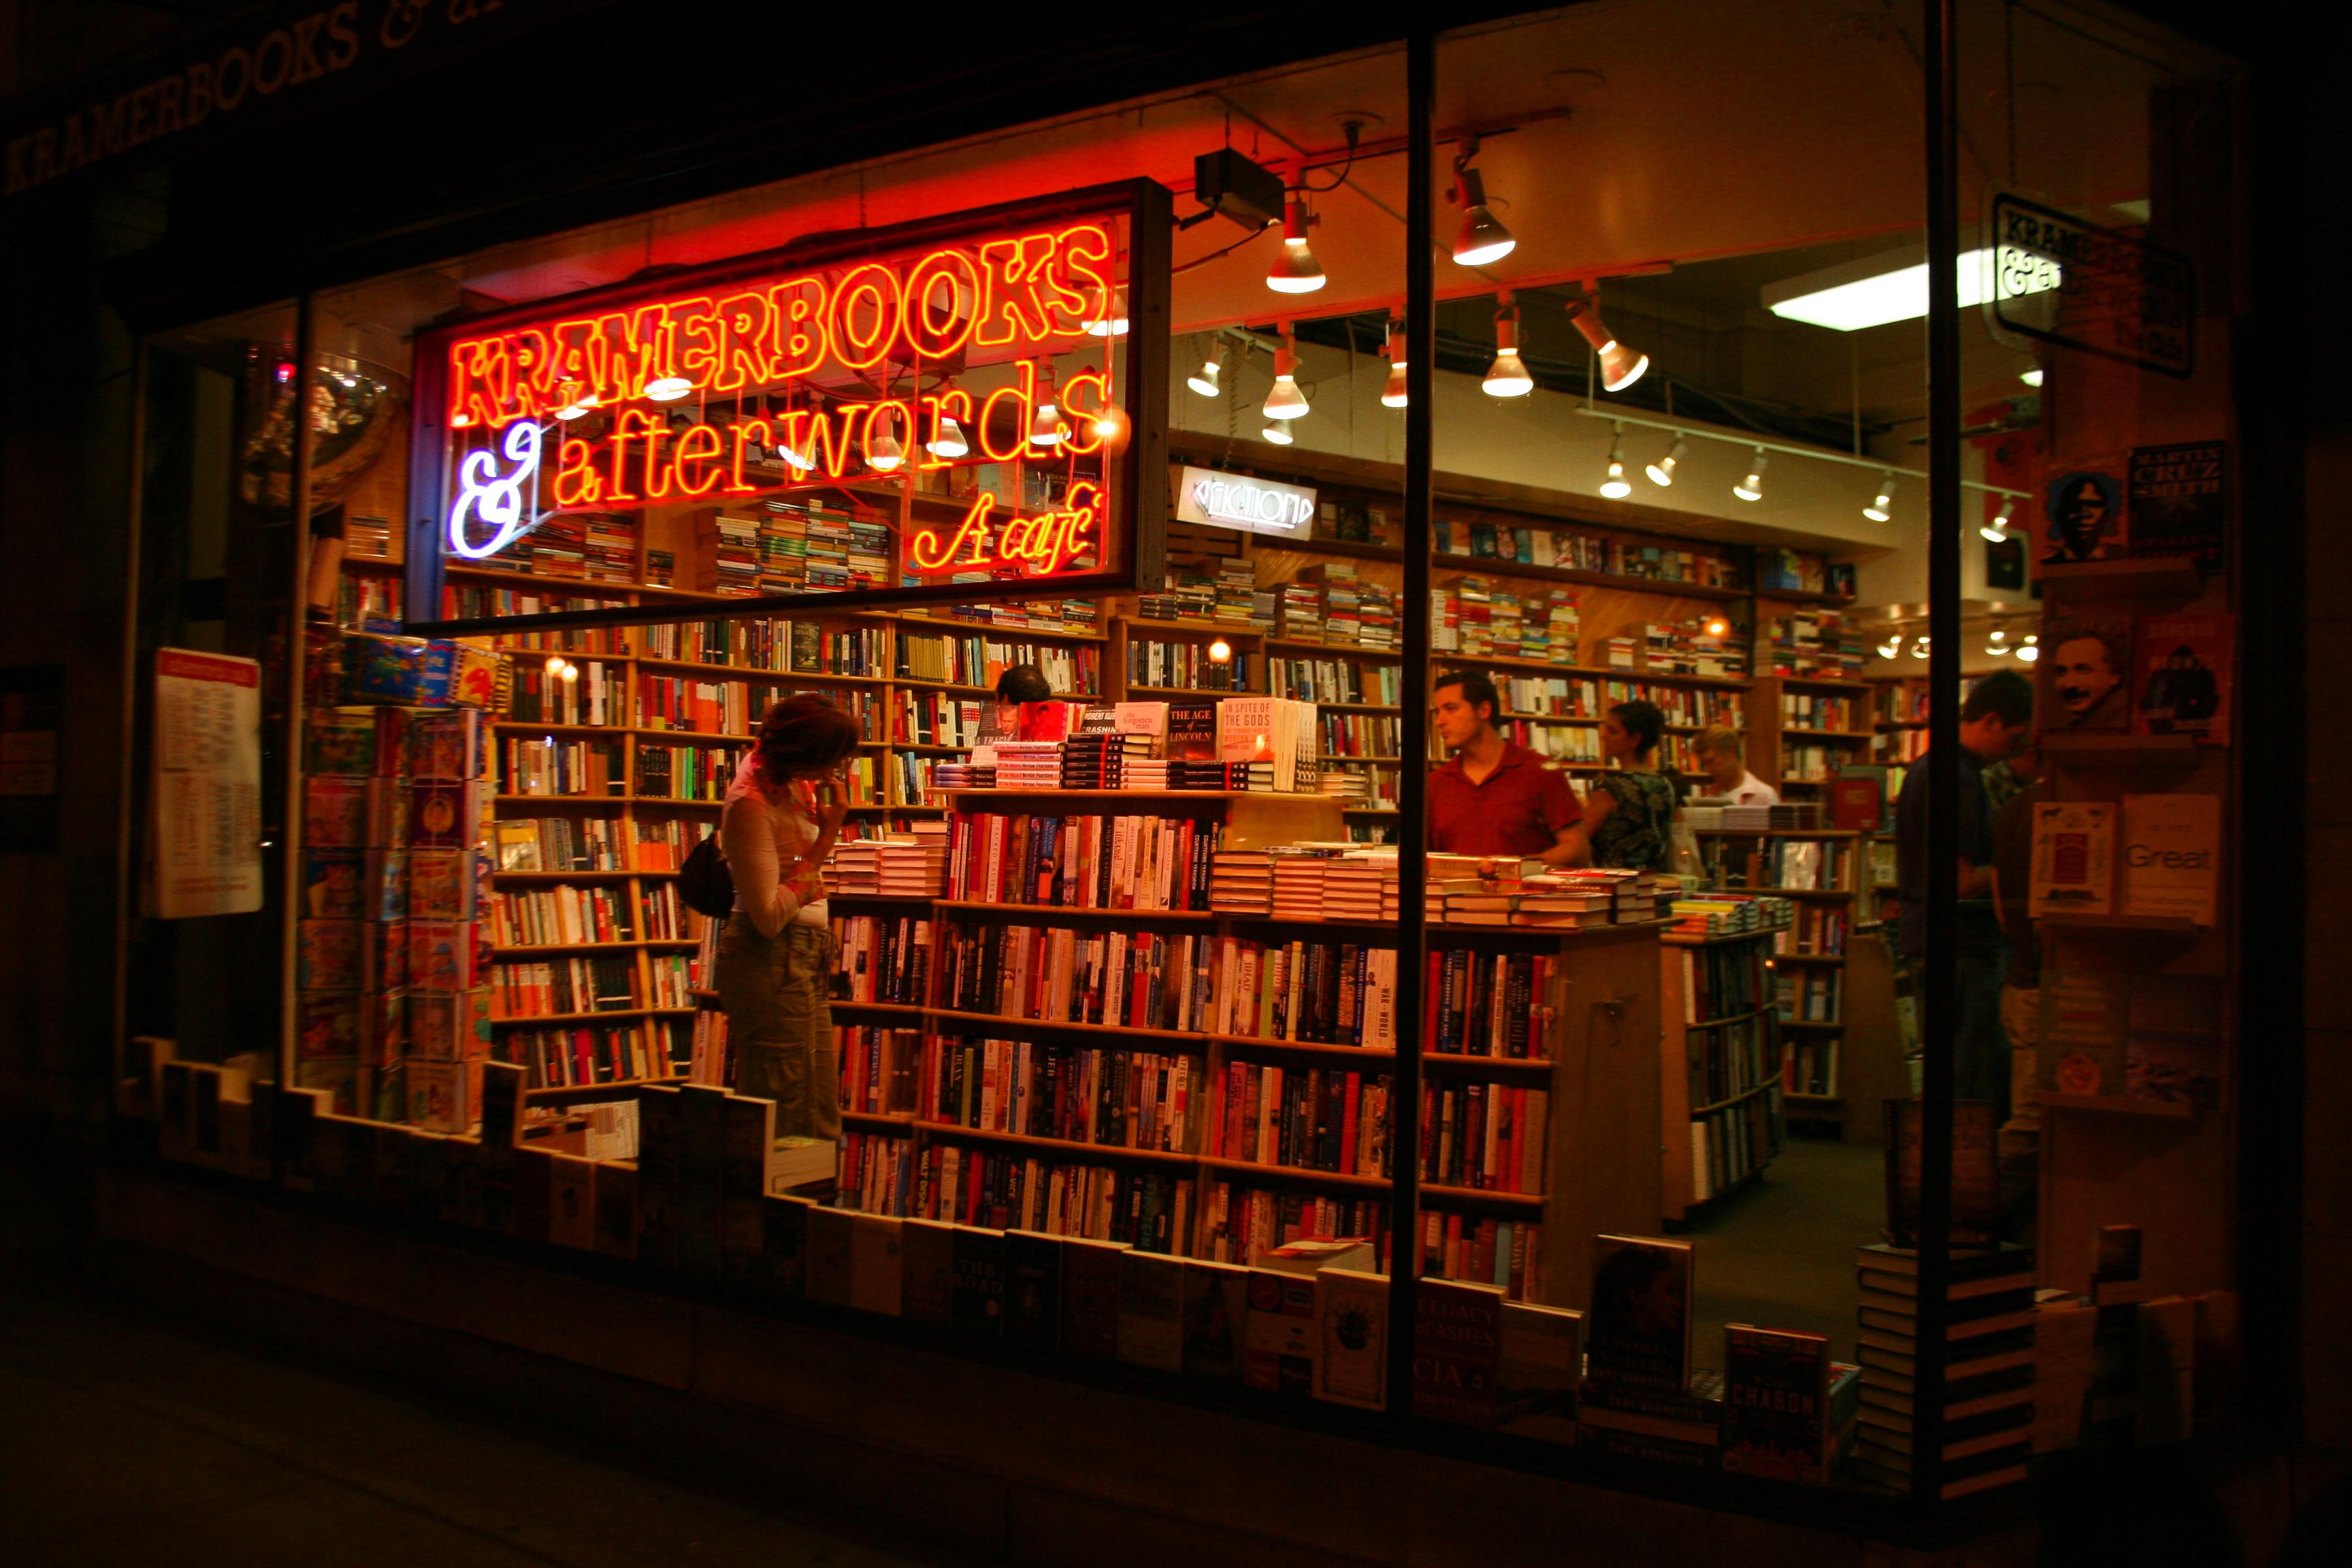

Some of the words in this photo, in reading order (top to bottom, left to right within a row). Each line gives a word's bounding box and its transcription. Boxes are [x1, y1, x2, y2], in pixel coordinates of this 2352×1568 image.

[1, 3, 360, 195] KRAMERBOOKS
[450, 224, 1110, 430] KRAMERBOOKS
[450, 418, 543, 559] &
[555, 360, 1110, 508] afterwords
[2134, 462, 2221, 483] CRUZ
[1208, 480, 1301, 525] FICTION
[914, 492, 991, 569] A
[1170, 710, 1190, 720] THE
[1192, 710, 1211, 719] AGE
[1226, 705, 1232, 713] IN
[1235, 704, 1257, 713] SPITE
[1260, 703, 1270, 712] OF
[1226, 715, 1240, 725] THE
[1244, 715, 1270, 725] GODS
[1170, 732, 1211, 741] LINCOLN
[1187, 721, 1194, 730] of
[2125, 844, 2211, 869] Great
[990, 862, 998, 892] CAUSES
[1243, 962, 1253, 991] JIHAD
[1380, 988, 1390, 1004] WAR
[1379, 1012, 1389, 1038] WORLD
[1309, 1072, 1317, 1092] IRAQ
[920, 1150, 930, 1178] WALT
[917, 1180, 928, 1215] DISNEY
[1416, 1296, 1493, 1326] LEGACY
[1434, 1324, 1494, 1347] ASHES
[1413, 1357, 1461, 1388] CIA
[1732, 1382, 1815, 1416] CHABON
